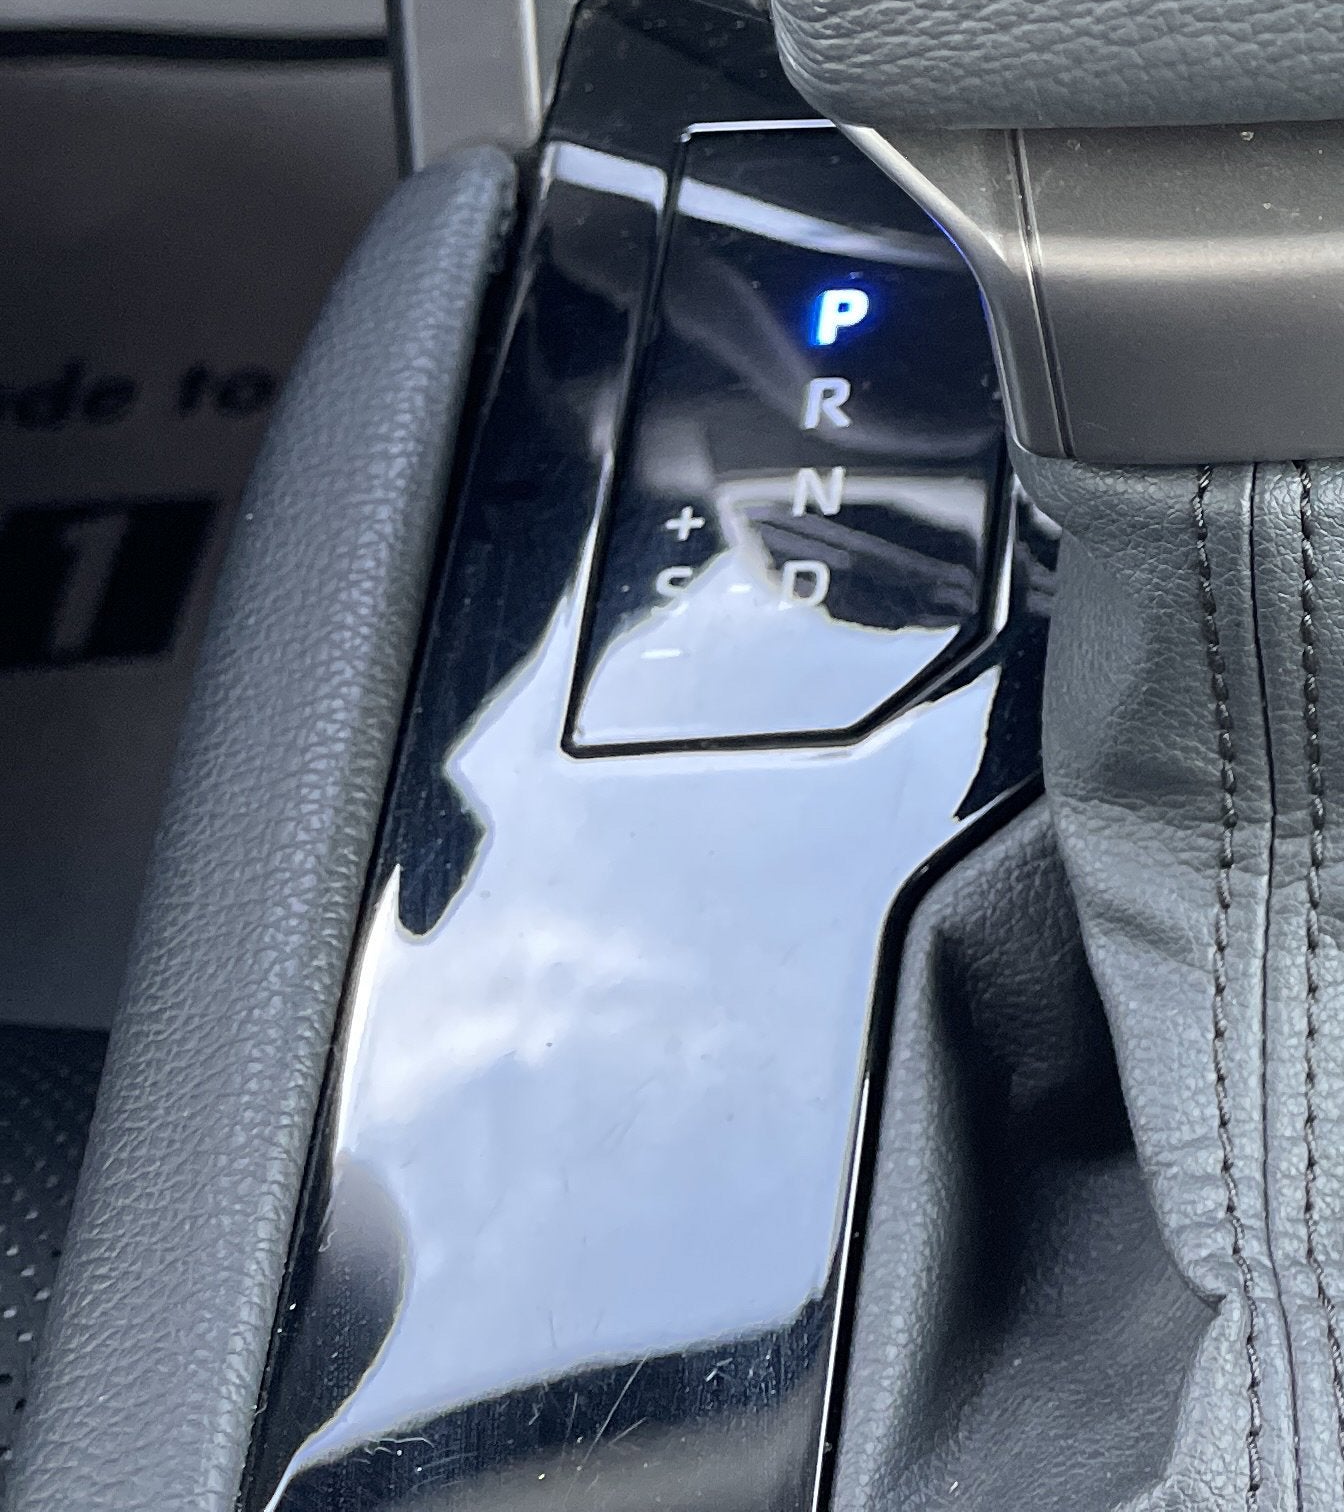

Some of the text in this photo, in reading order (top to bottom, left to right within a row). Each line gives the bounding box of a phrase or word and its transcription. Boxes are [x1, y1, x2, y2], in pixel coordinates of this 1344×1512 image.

[815, 289, 869, 345] P
[805, 377, 852, 429] R
[792, 466, 846, 517] N
[780, 560, 831, 610] D
